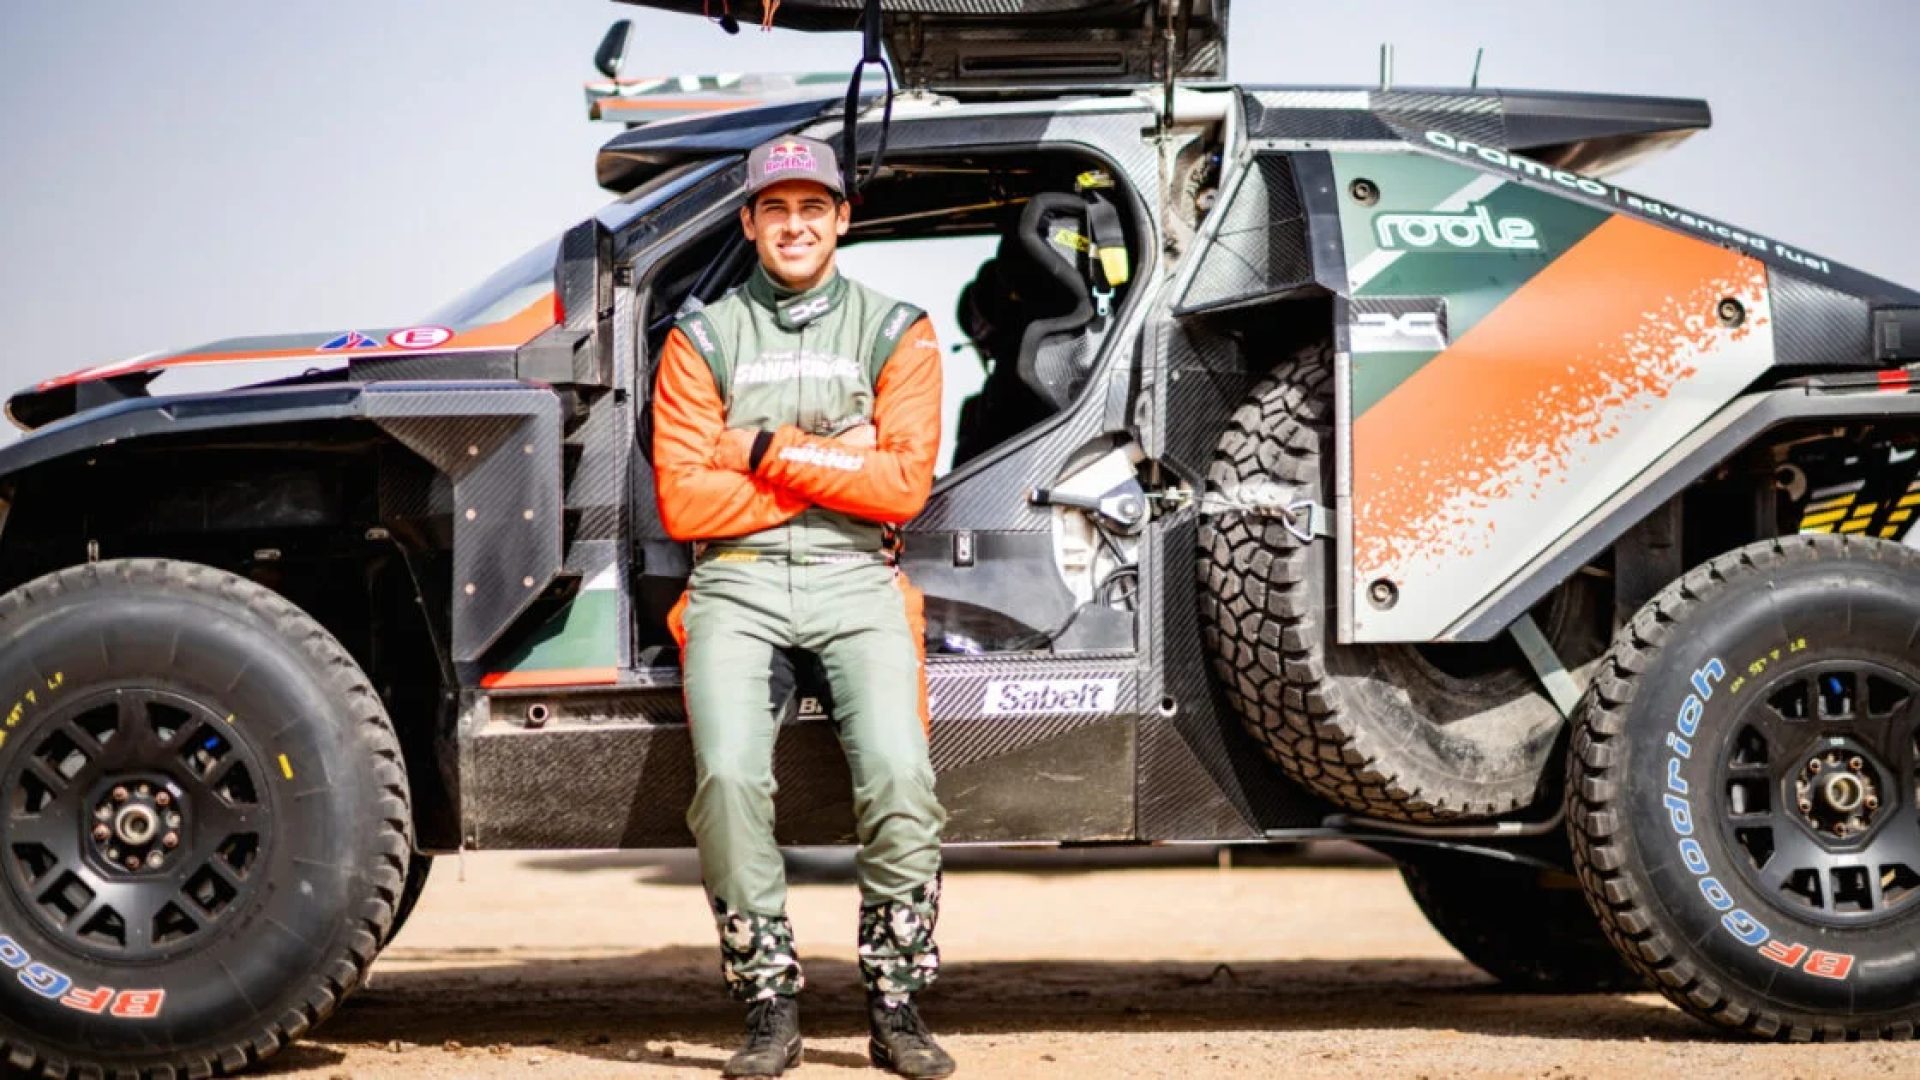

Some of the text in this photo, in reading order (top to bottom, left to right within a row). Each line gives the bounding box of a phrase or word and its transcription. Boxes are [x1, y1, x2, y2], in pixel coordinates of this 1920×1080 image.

[1425, 131, 1831, 274] aramco advanced fuel
[998, 683, 1104, 711] Sabelt
[1664, 658, 1854, 979] BFGoodrich
